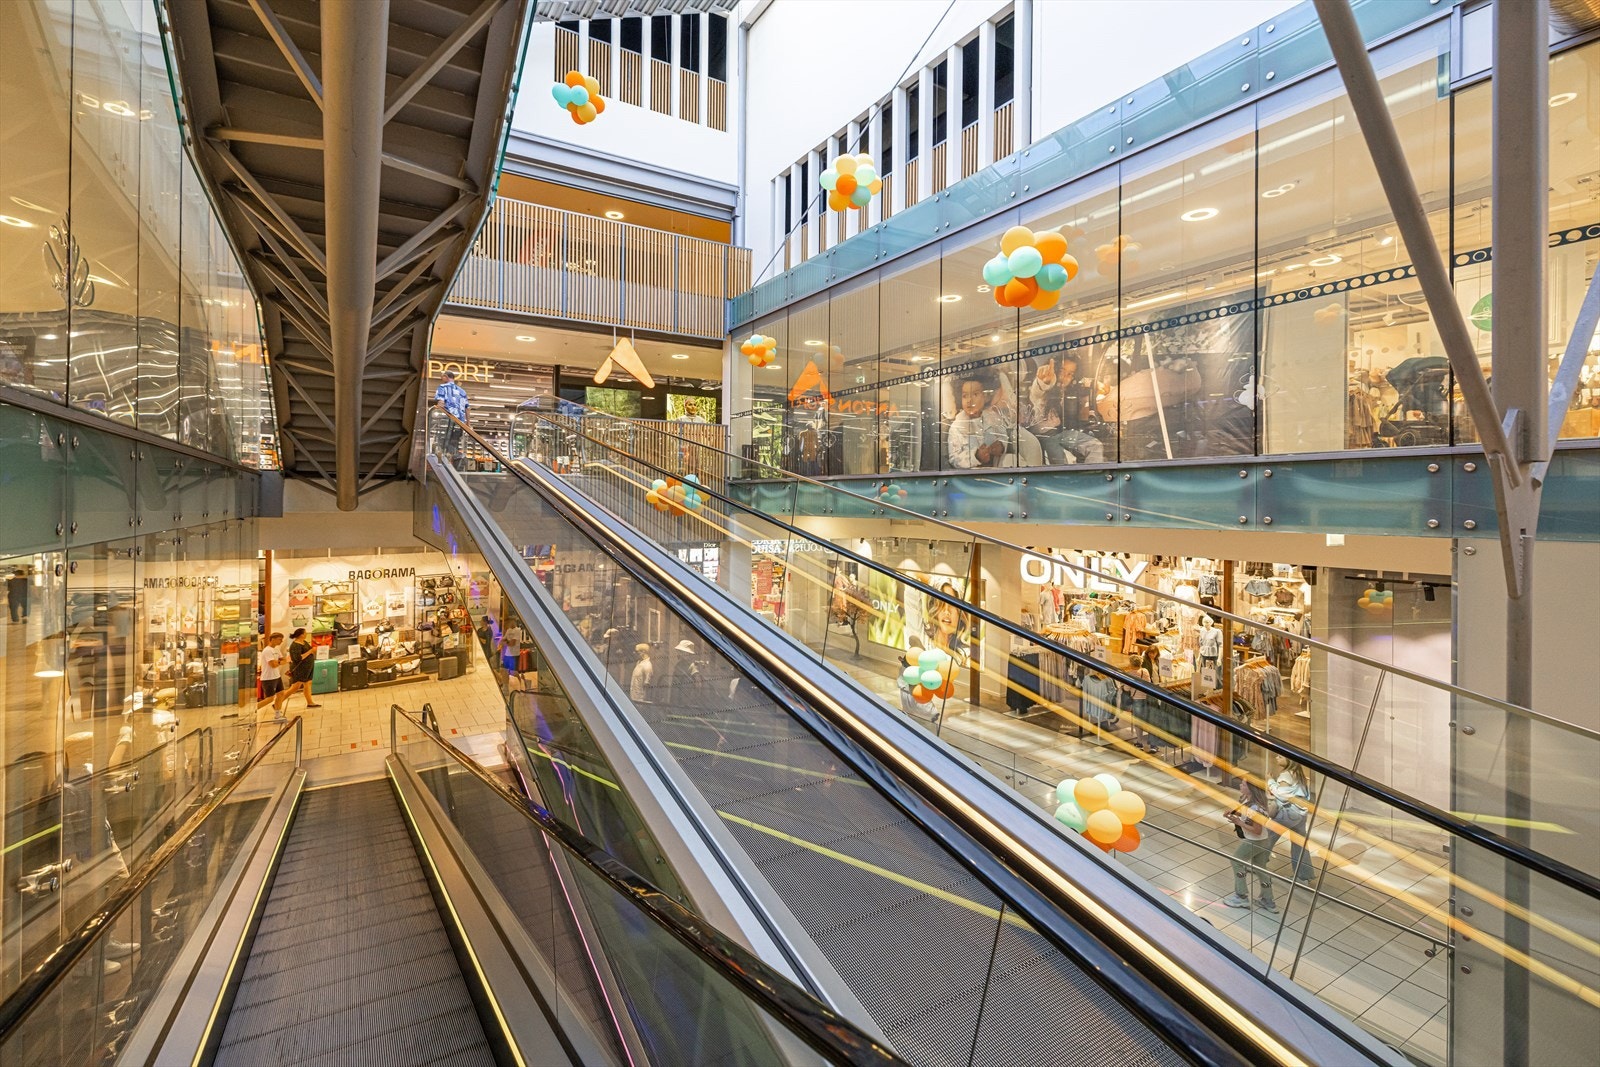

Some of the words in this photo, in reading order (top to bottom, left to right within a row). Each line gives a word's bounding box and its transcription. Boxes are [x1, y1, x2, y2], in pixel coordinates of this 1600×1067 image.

[428, 360, 495, 383] PORT
[348, 567, 416, 580] BAGORAMA
[1020, 553, 1149, 594] ONLY
[871, 599, 900, 613] ONLY
